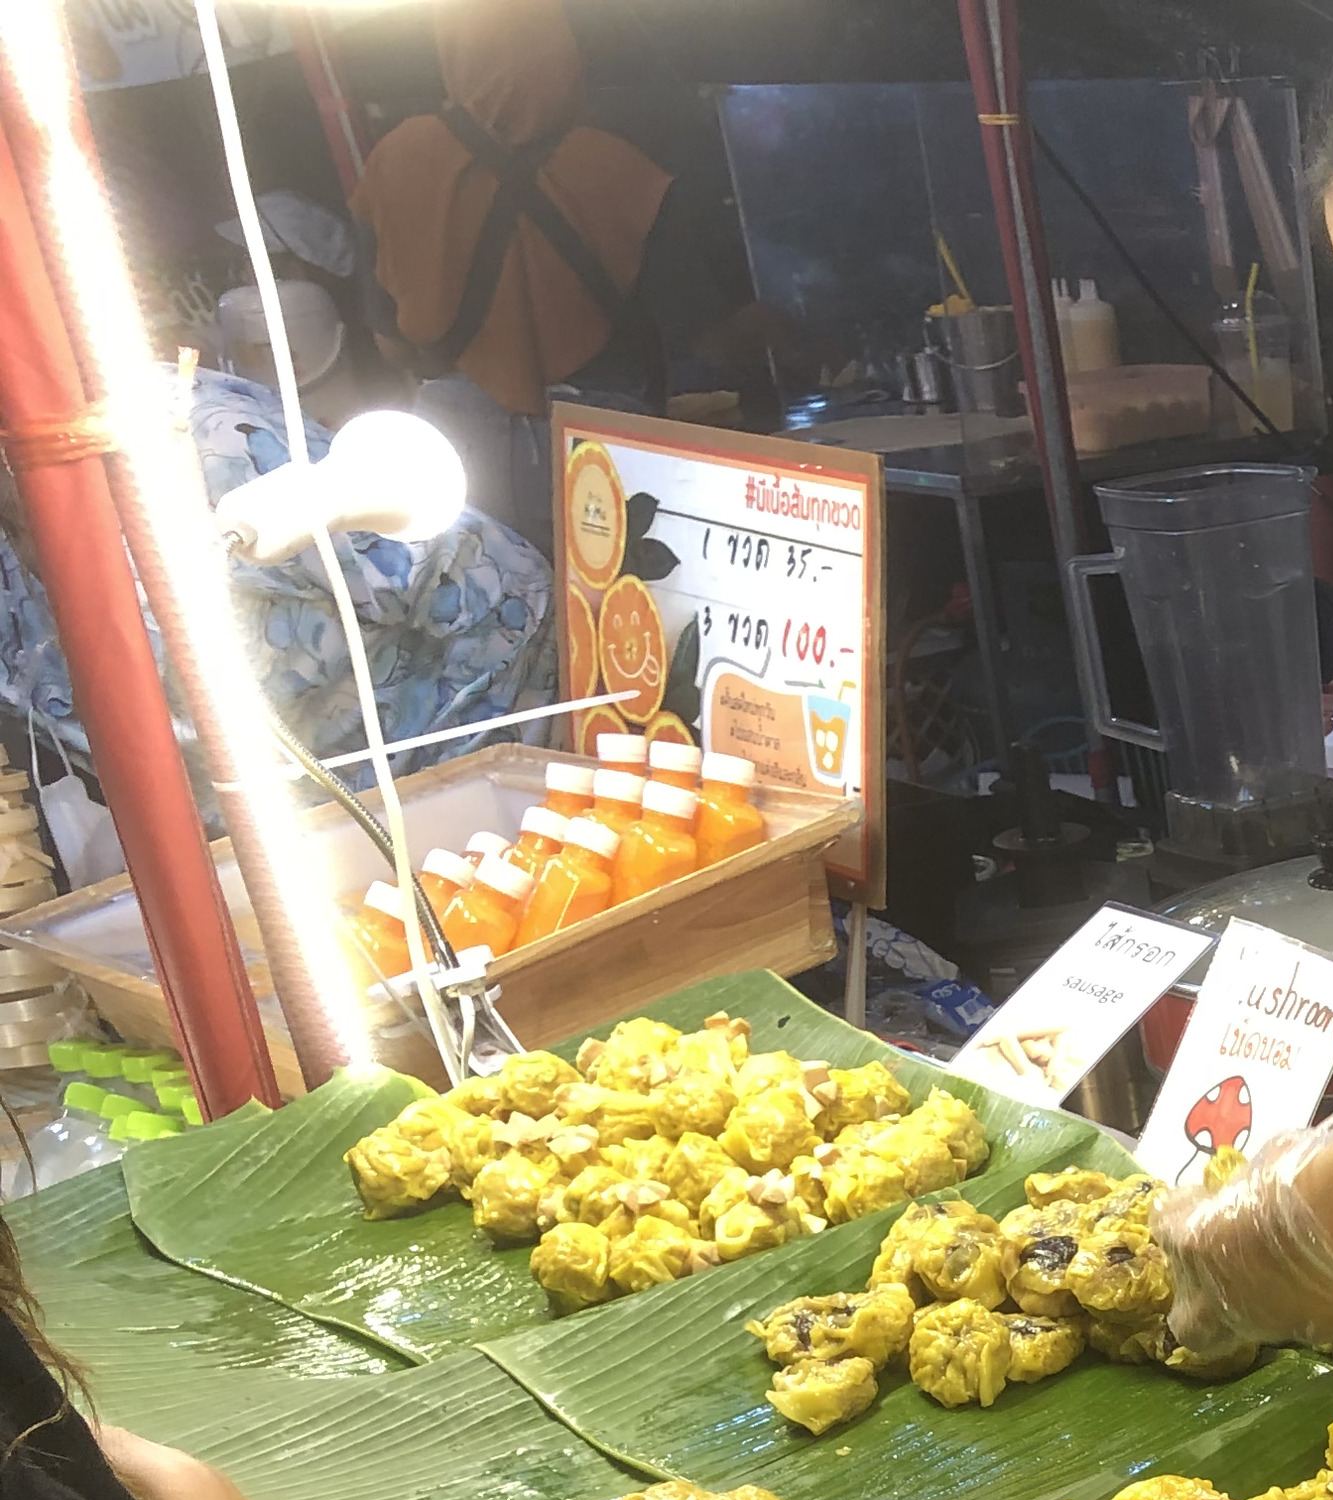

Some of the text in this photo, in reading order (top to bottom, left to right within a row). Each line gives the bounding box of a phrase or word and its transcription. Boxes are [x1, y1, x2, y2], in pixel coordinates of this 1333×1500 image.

[703, 528, 710, 560] 1
[728, 533, 770, 571] ขวด
[703, 606, 713, 636] 3
[728, 613, 769, 650] ขวด
[1062, 976, 1124, 1004] sausage
